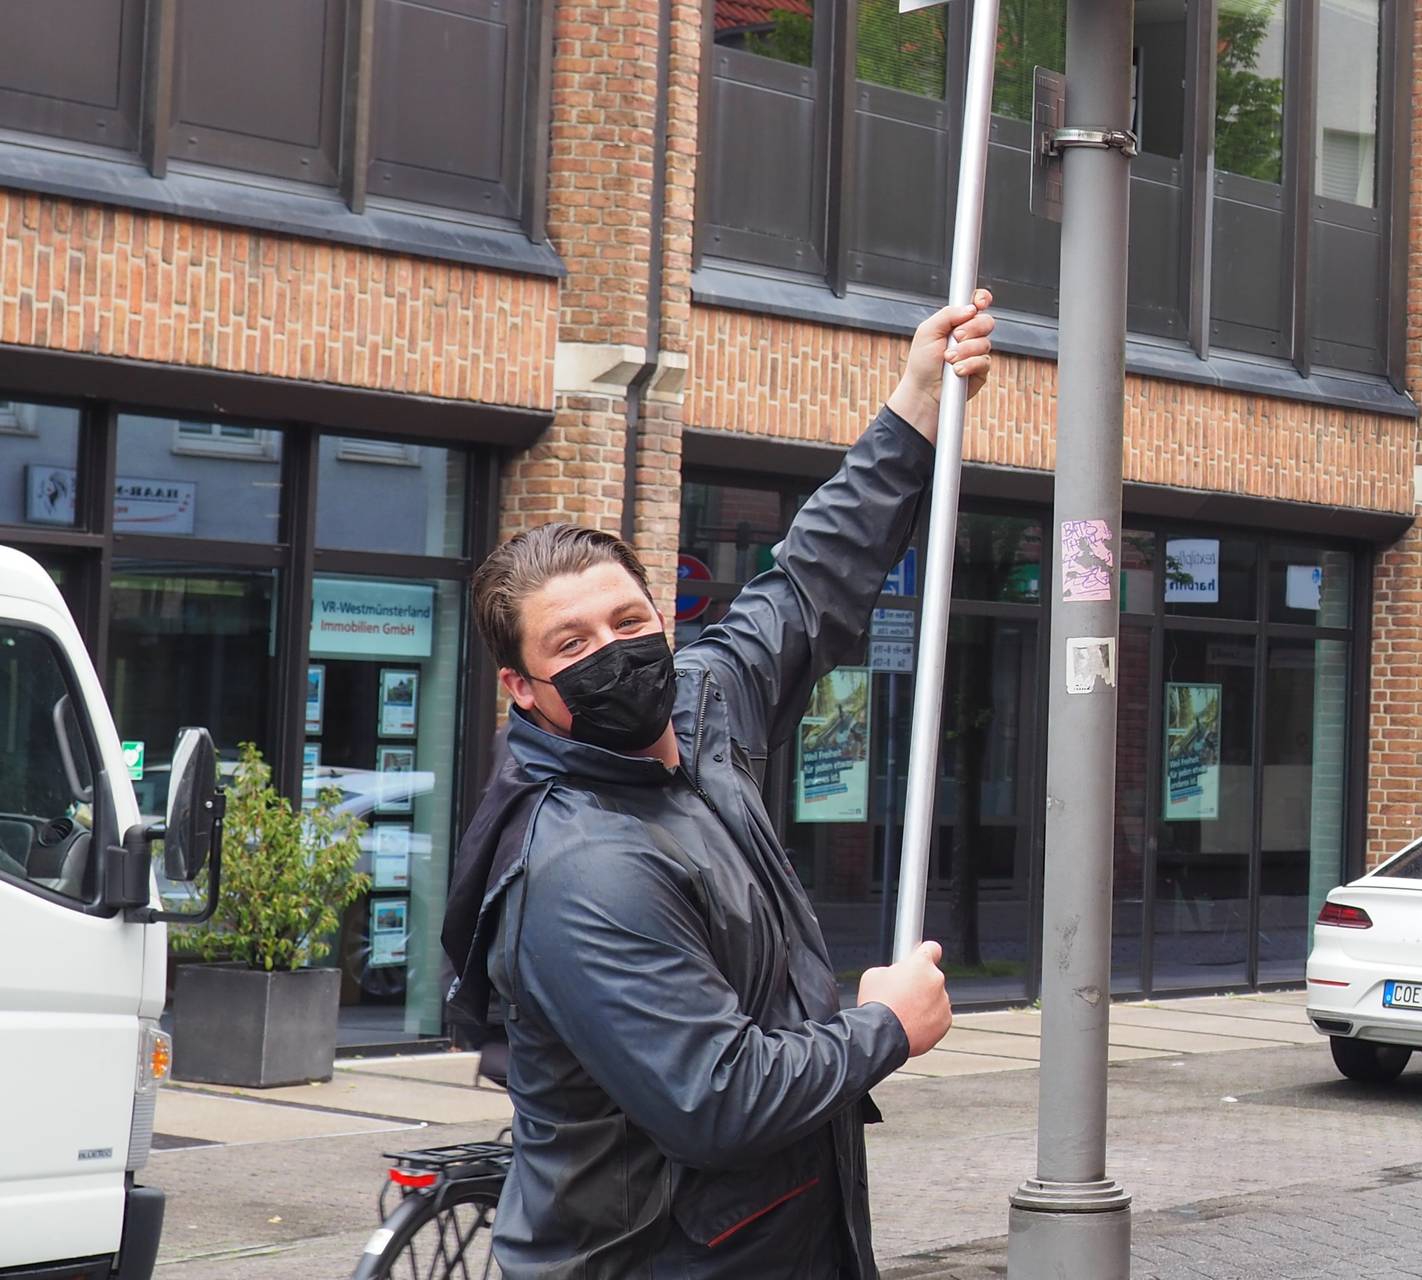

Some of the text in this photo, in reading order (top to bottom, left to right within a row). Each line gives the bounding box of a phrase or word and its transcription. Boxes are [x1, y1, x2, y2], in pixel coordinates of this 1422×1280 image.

[322, 601, 430, 618] VR-Westmünsterland
[321, 620, 415, 635] Immobilien GmbH
[1394, 985, 1421, 1004] COE
